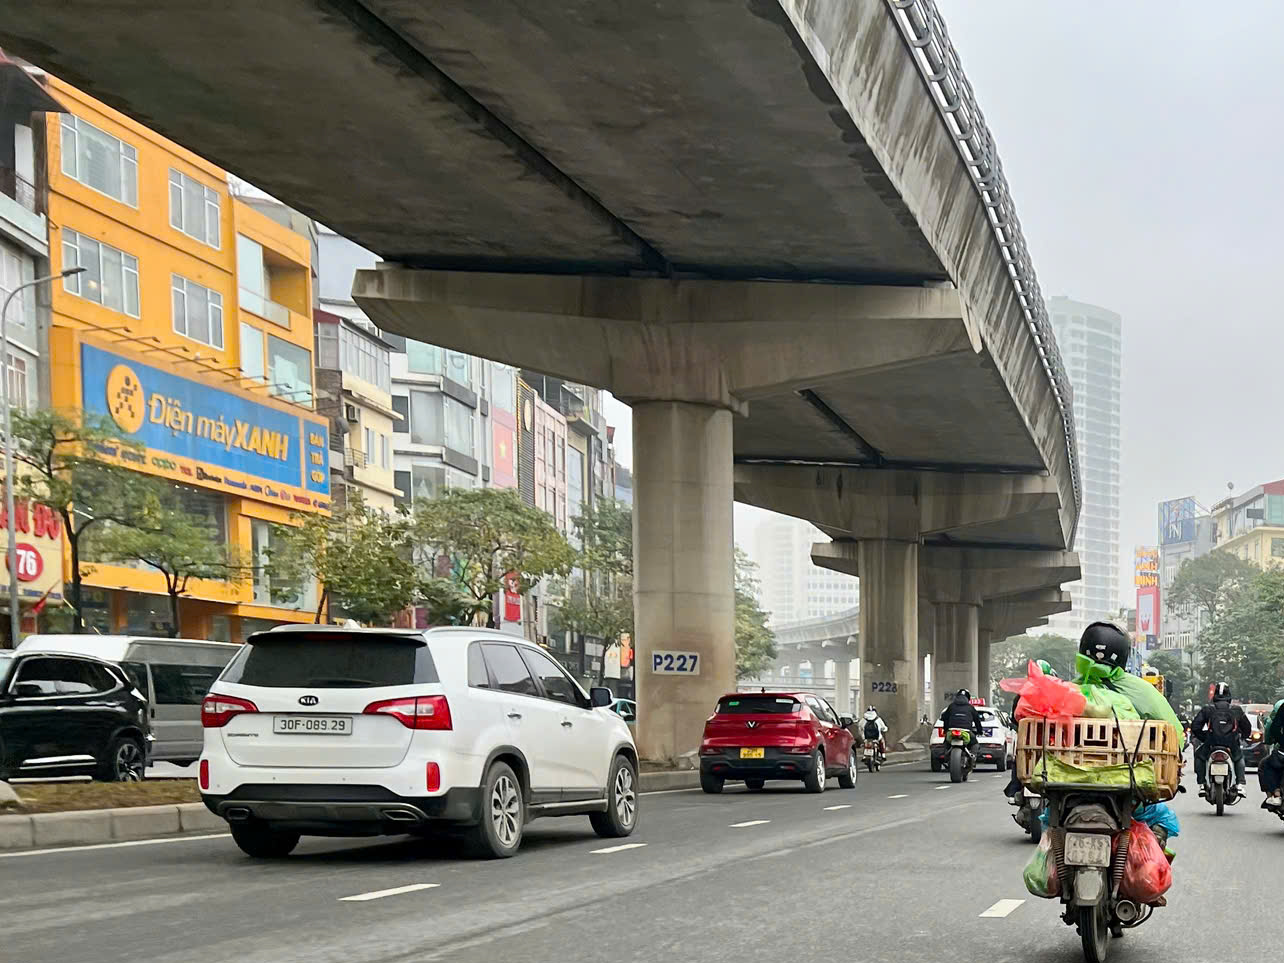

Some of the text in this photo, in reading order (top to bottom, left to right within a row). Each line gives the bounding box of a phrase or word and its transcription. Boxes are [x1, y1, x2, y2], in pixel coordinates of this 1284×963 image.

[148, 393, 193, 438] Điện
[16, 549, 37, 576] 76
[653, 654, 699, 671] P227
[280, 719, 346, 730] 30F-089.29
